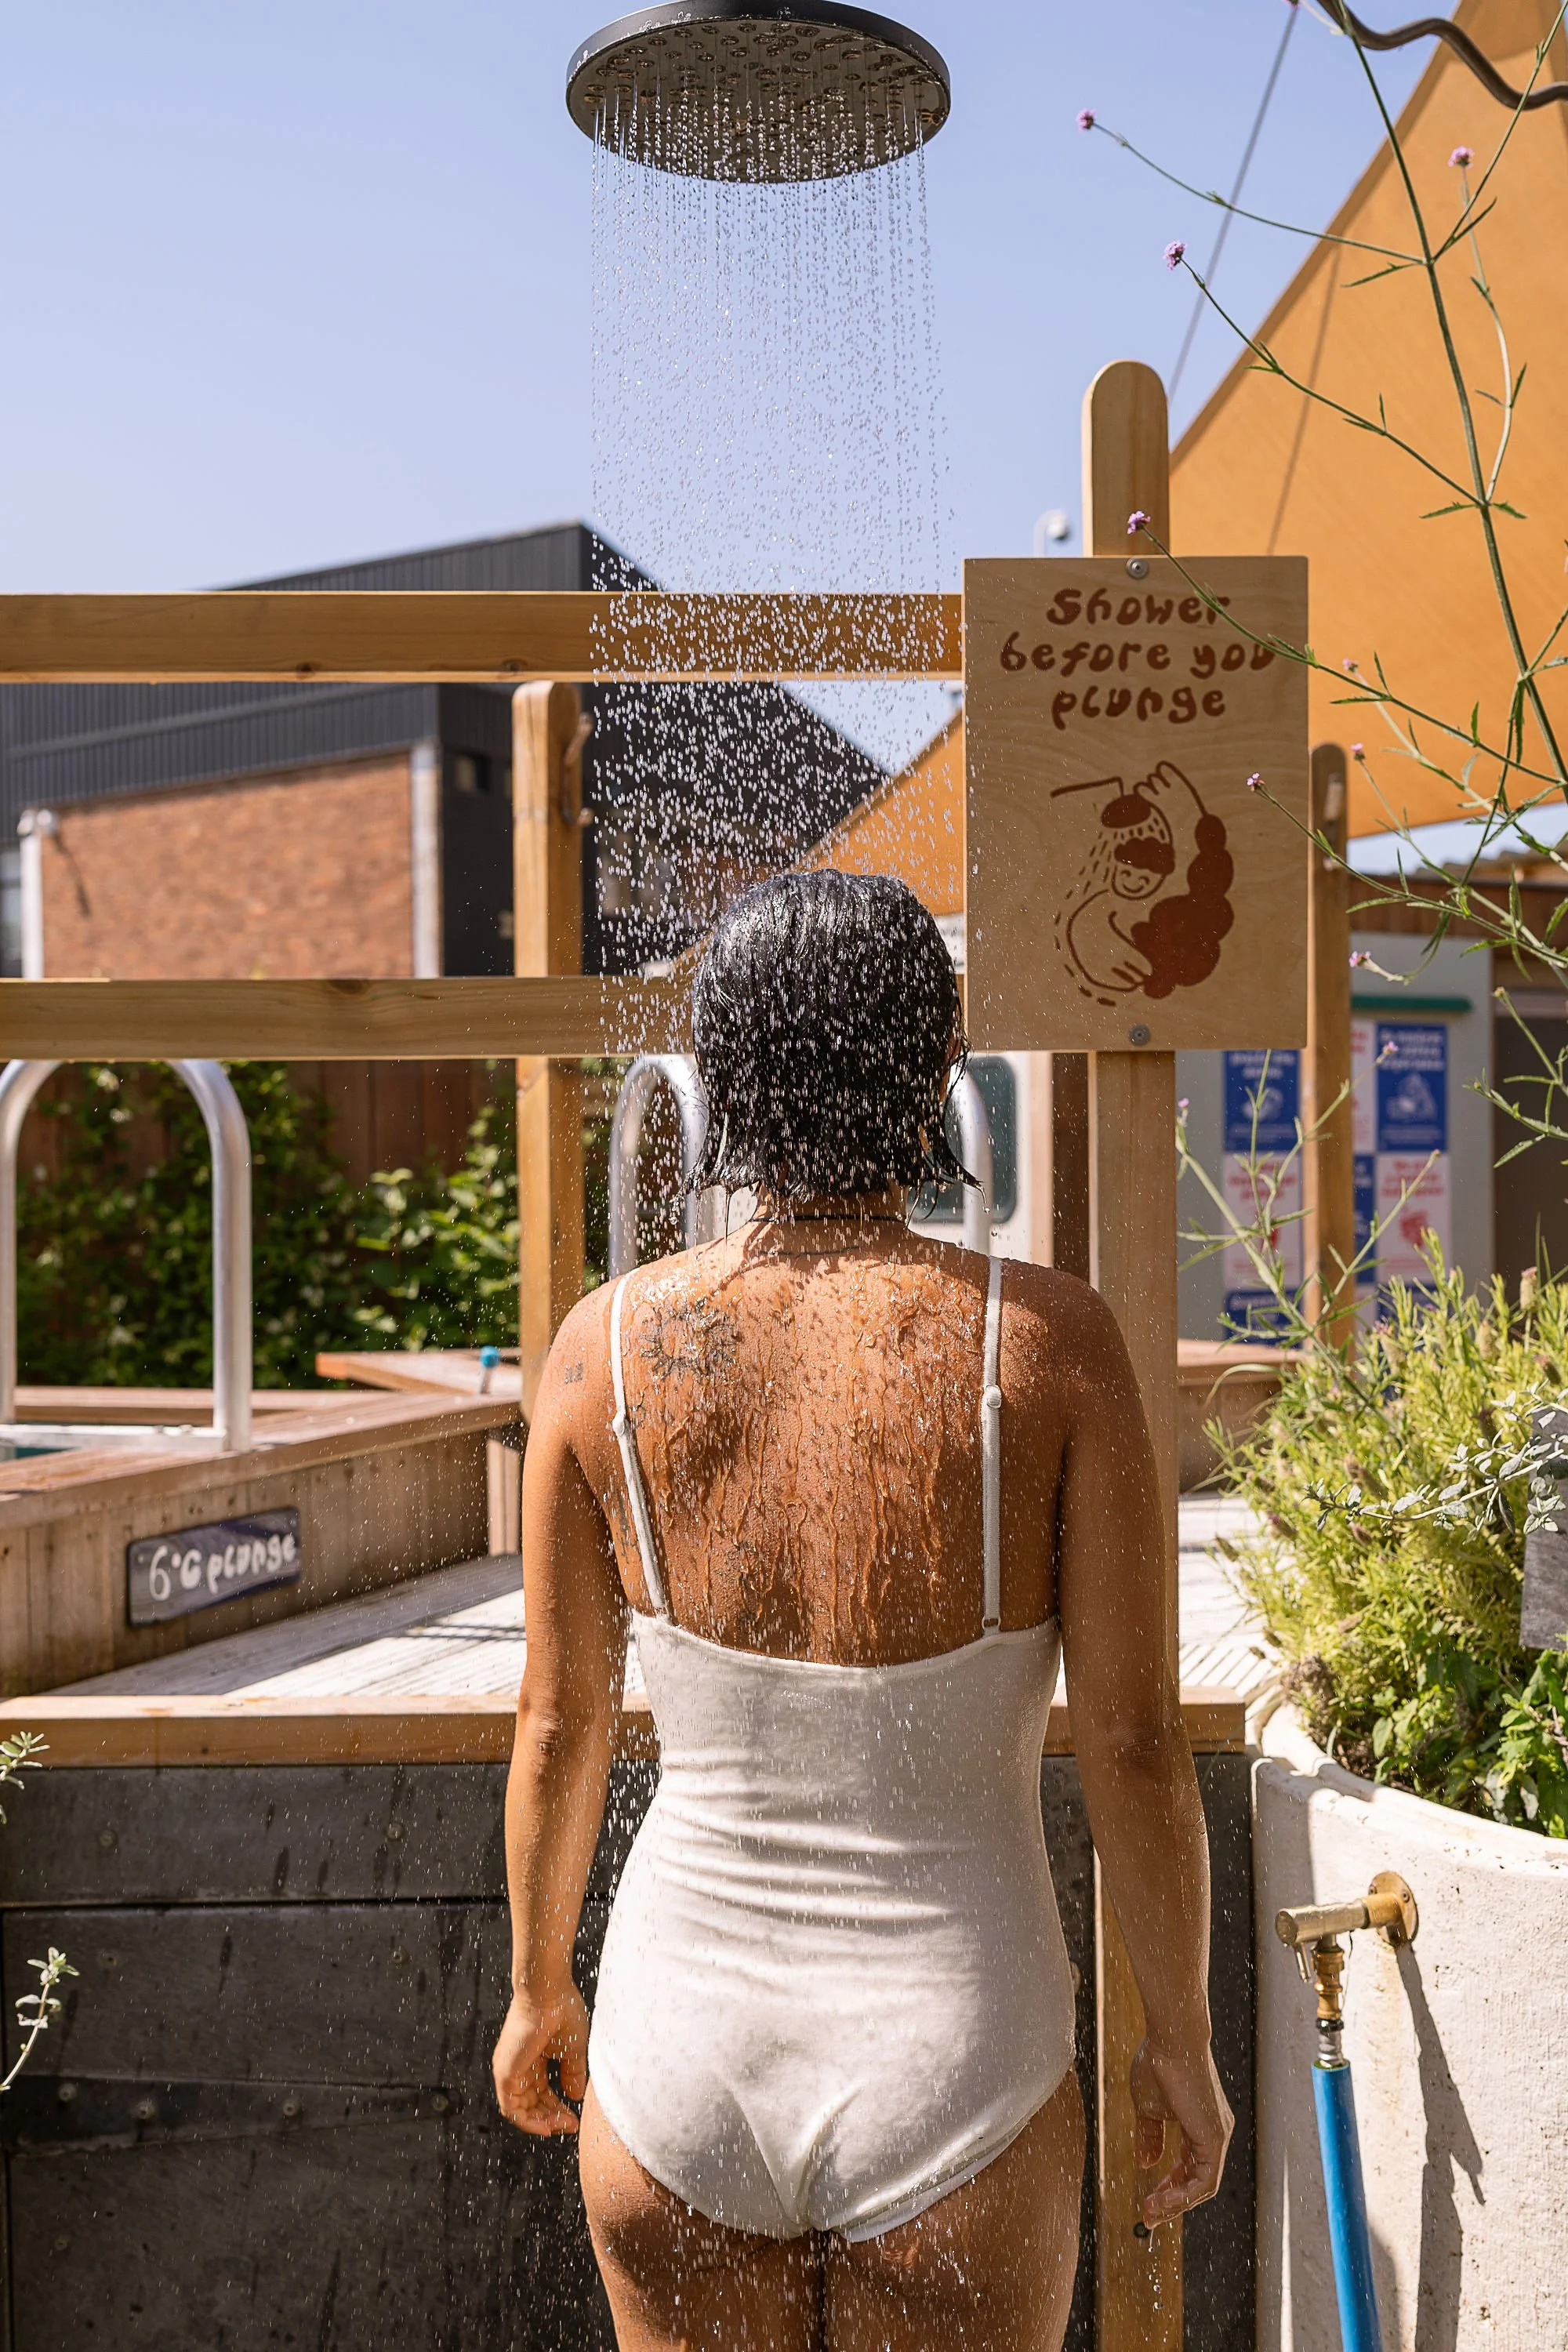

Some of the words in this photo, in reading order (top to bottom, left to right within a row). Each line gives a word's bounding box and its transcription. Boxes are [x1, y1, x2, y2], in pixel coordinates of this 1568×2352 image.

[1046, 587, 1231, 626] Shower
[1000, 630, 1171, 678] before
[1189, 640, 1276, 680] you
[1051, 684, 1226, 731] plunge
[207, 1533, 297, 1595] plunge
